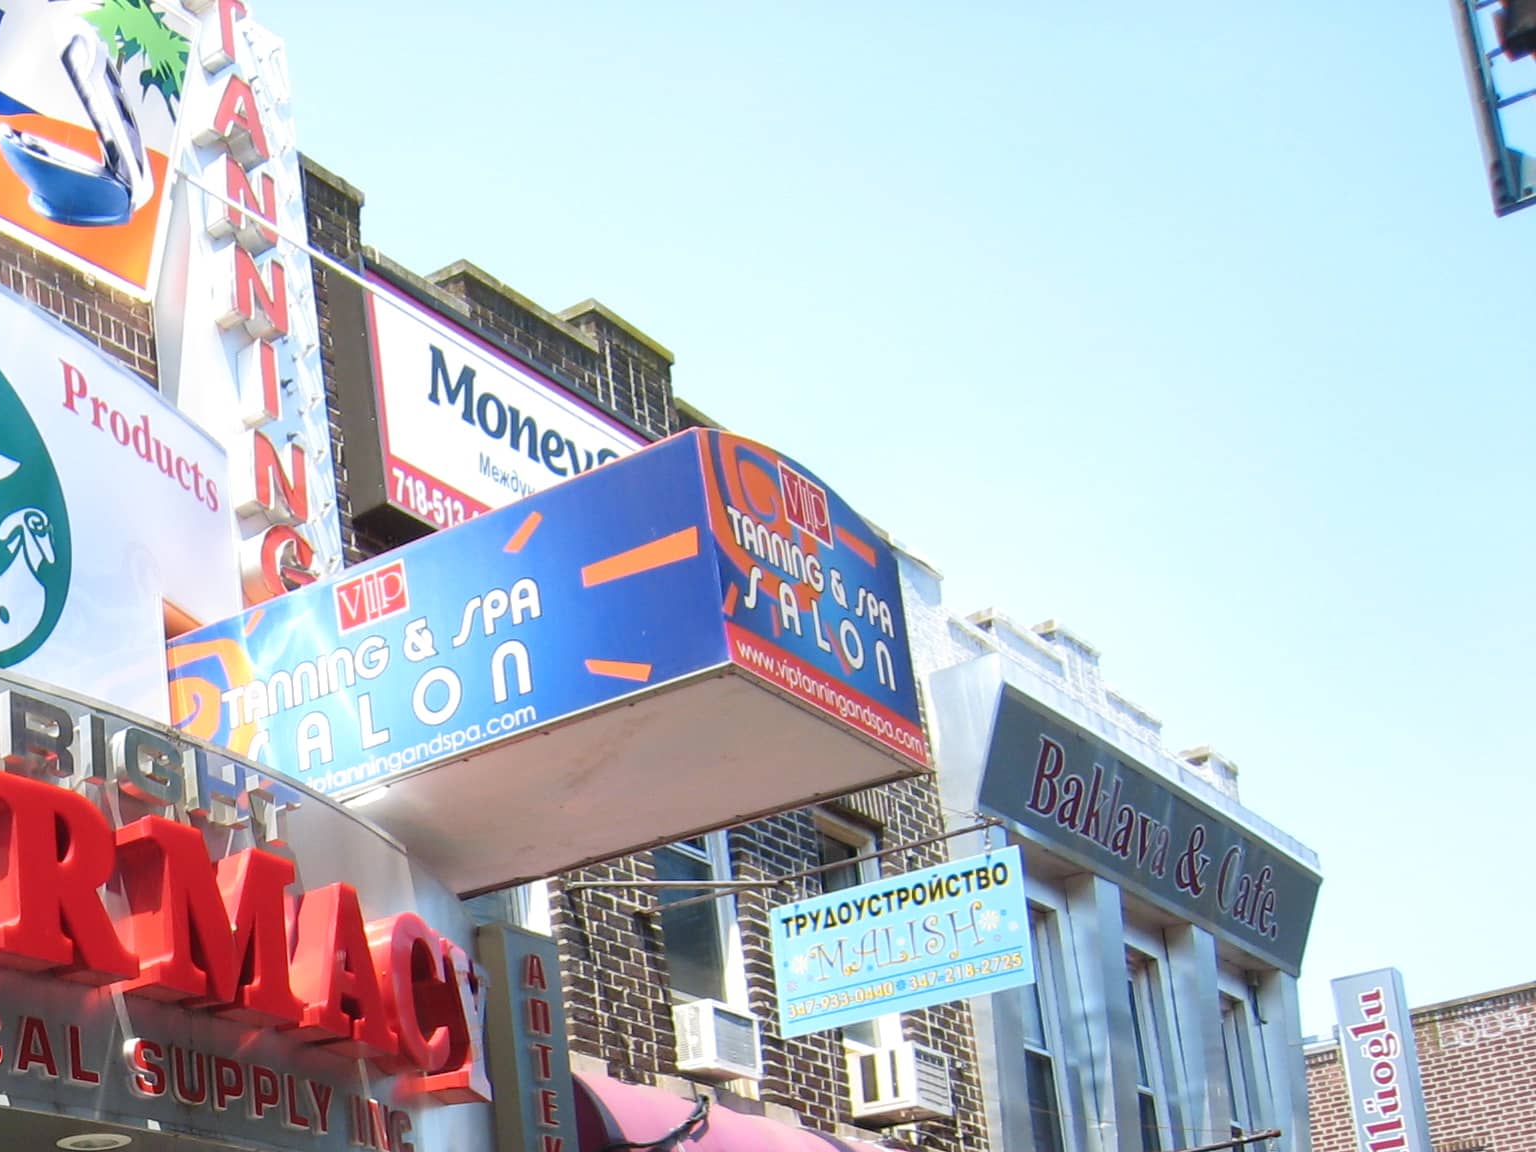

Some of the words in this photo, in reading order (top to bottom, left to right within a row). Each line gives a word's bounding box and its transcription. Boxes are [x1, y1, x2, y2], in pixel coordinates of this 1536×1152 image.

[58, 358, 219, 514] Products
[428, 343, 624, 477] Money
[391, 466, 486, 530] 718-513-
[782, 472, 830, 537] VIP
[337, 566, 405, 624] VIP
[726, 504, 825, 593] TANNING
[830, 567, 849, 610] &
[854, 584, 896, 639] SPA
[743, 564, 897, 692] SALON
[220, 633, 390, 730] TANNING
[401, 616, 439, 663] &
[451, 576, 543, 648] SPA
[1026, 733, 1171, 879] Baklava
[1175, 824, 1211, 899] &
[780, 861, 1010, 940] ТРУДОУСТРОЙСТВО
[124, 1034, 334, 1135] SUPPLY
